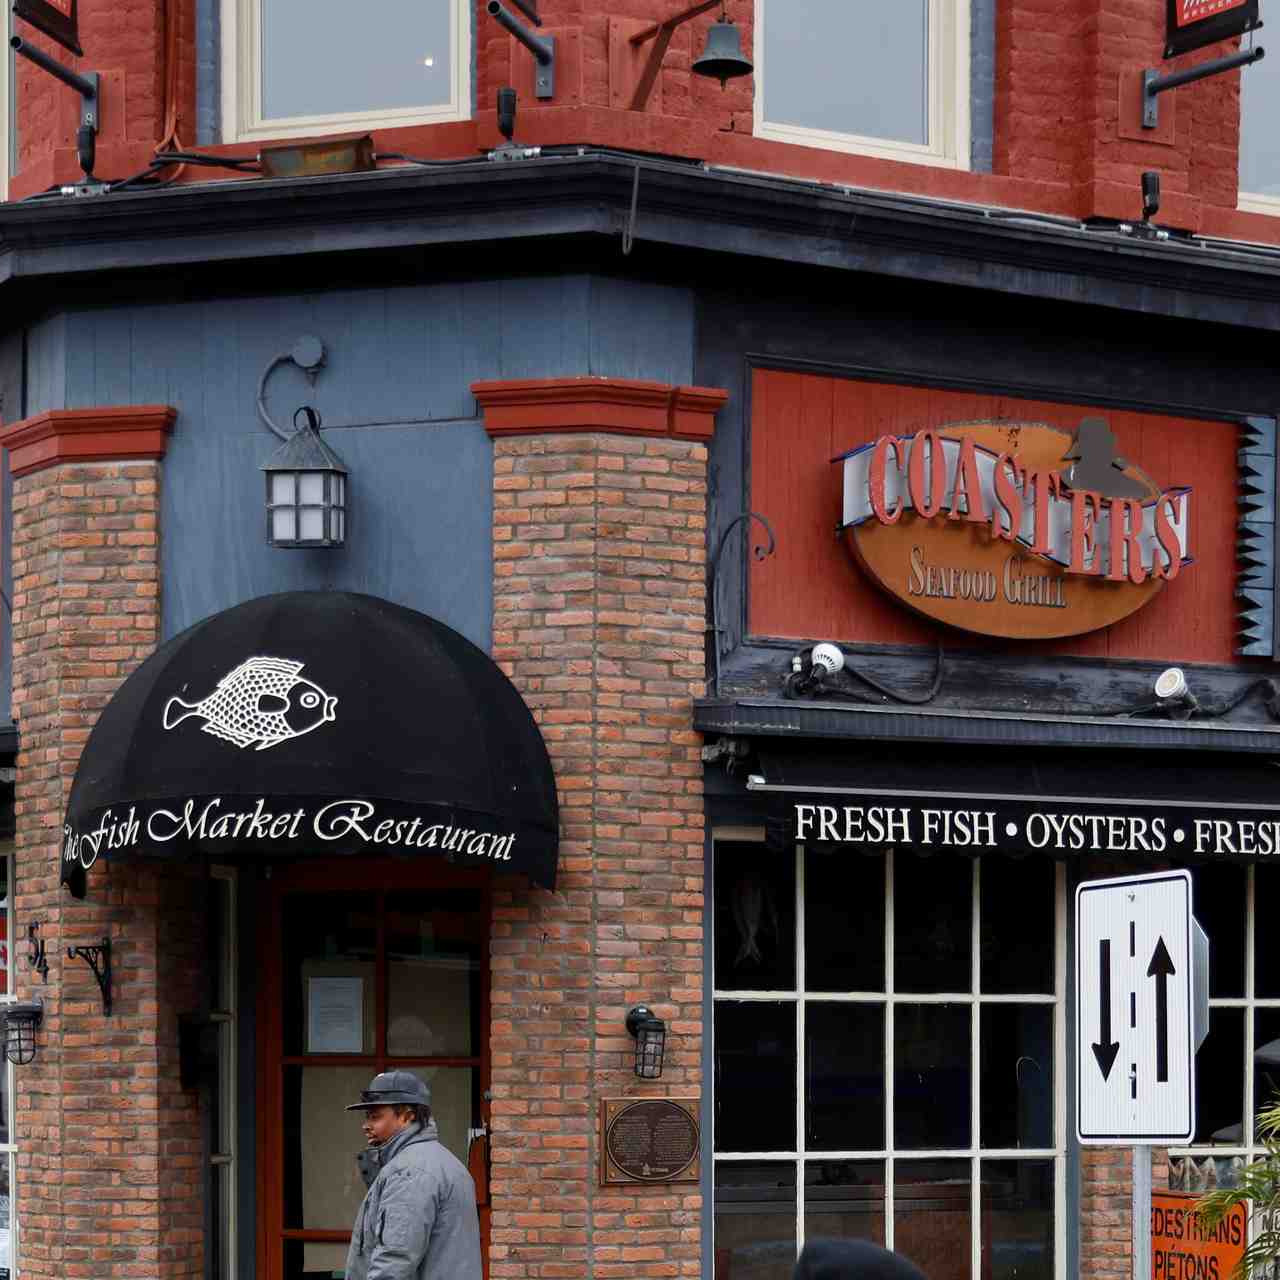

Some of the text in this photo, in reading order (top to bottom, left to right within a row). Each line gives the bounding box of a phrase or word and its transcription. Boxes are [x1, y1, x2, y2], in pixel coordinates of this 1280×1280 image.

[869, 429, 1185, 585] COASTERS
[80, 806, 141, 870] Fish
[148, 798, 306, 843] Market
[313, 800, 517, 862] Restaurant
[793, 804, 913, 843] FRESH
[920, 809, 999, 847] FISH
[1025, 812, 1167, 852] OYSTERS
